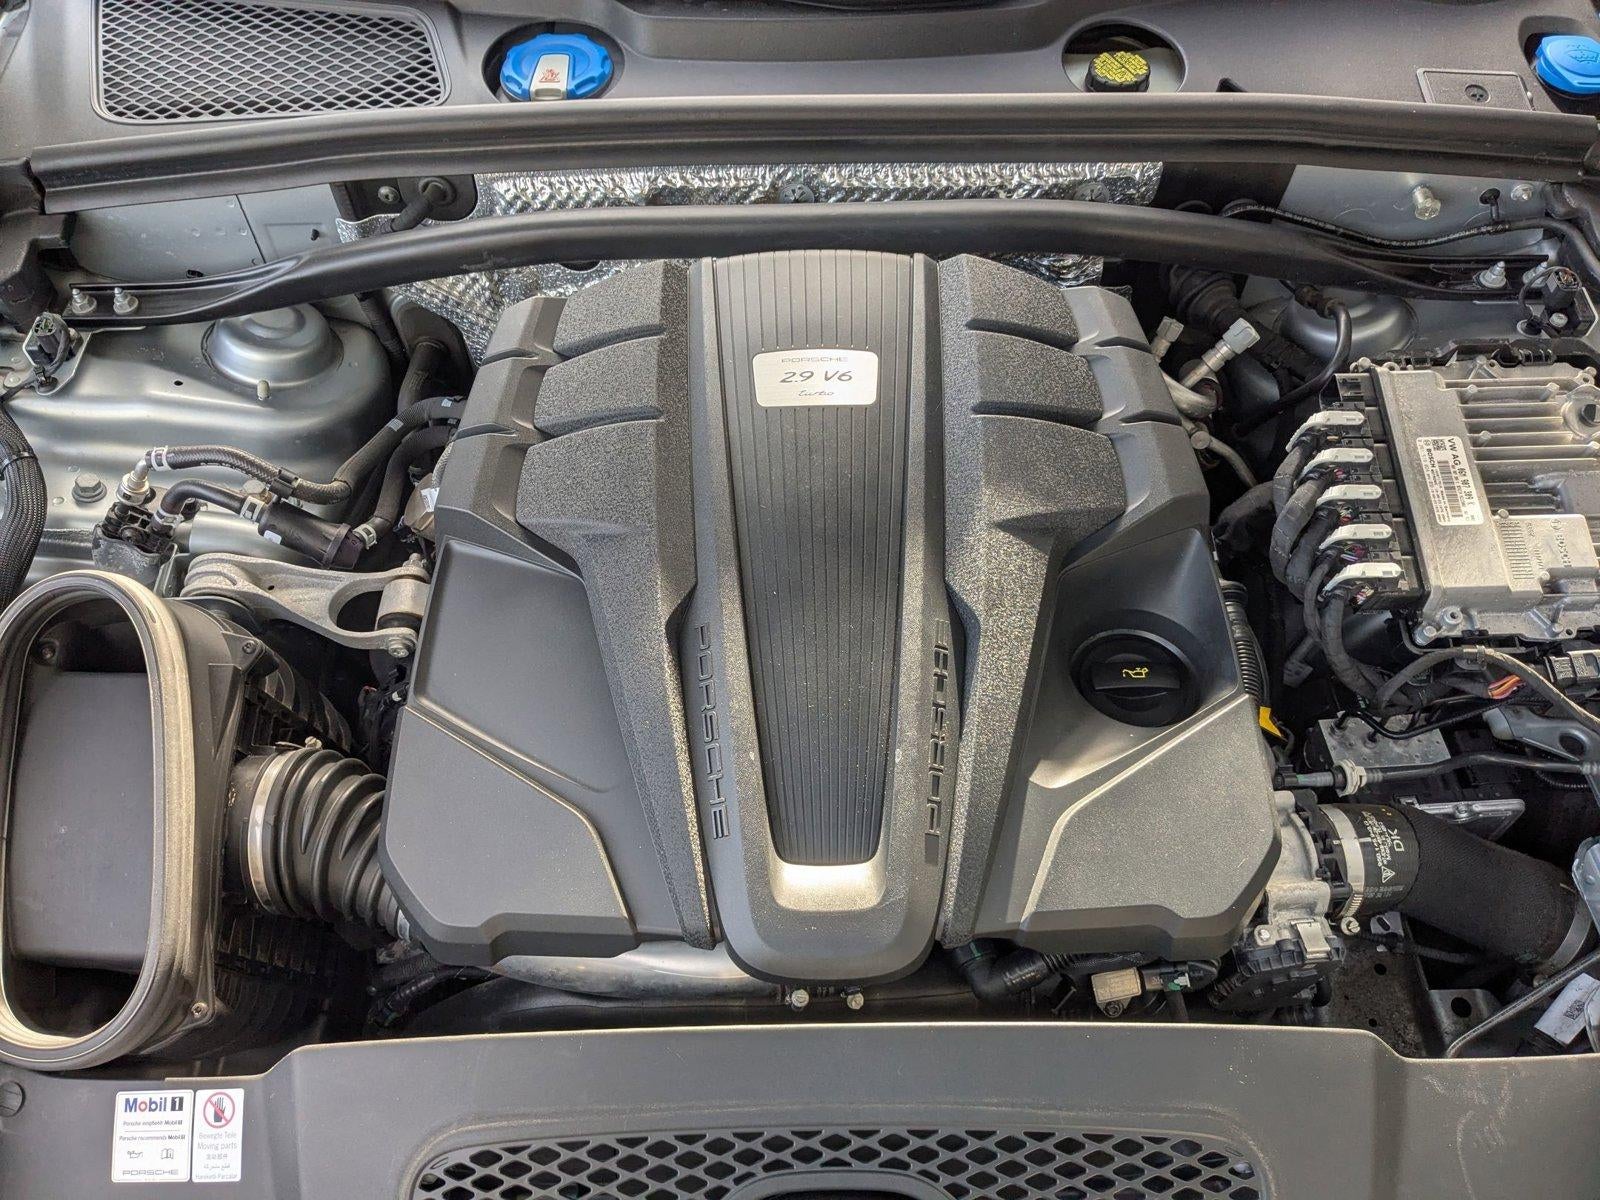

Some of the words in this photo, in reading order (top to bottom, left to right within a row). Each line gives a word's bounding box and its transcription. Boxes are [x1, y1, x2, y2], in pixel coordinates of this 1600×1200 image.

[779, 370, 814, 383] 2.9
[824, 370, 853, 382] V6
[1448, 438, 1457, 452] VW
[1426, 448, 1436, 469] BOSCH
[1452, 453, 1461, 466] AG
[695, 624, 730, 840] PORSCHE
[924, 617, 950, 835] PORSCHE
[1387, 828, 1405, 852] DK
[124, 1097, 168, 1113] Mobil
[170, 1096, 184, 1112] 1
